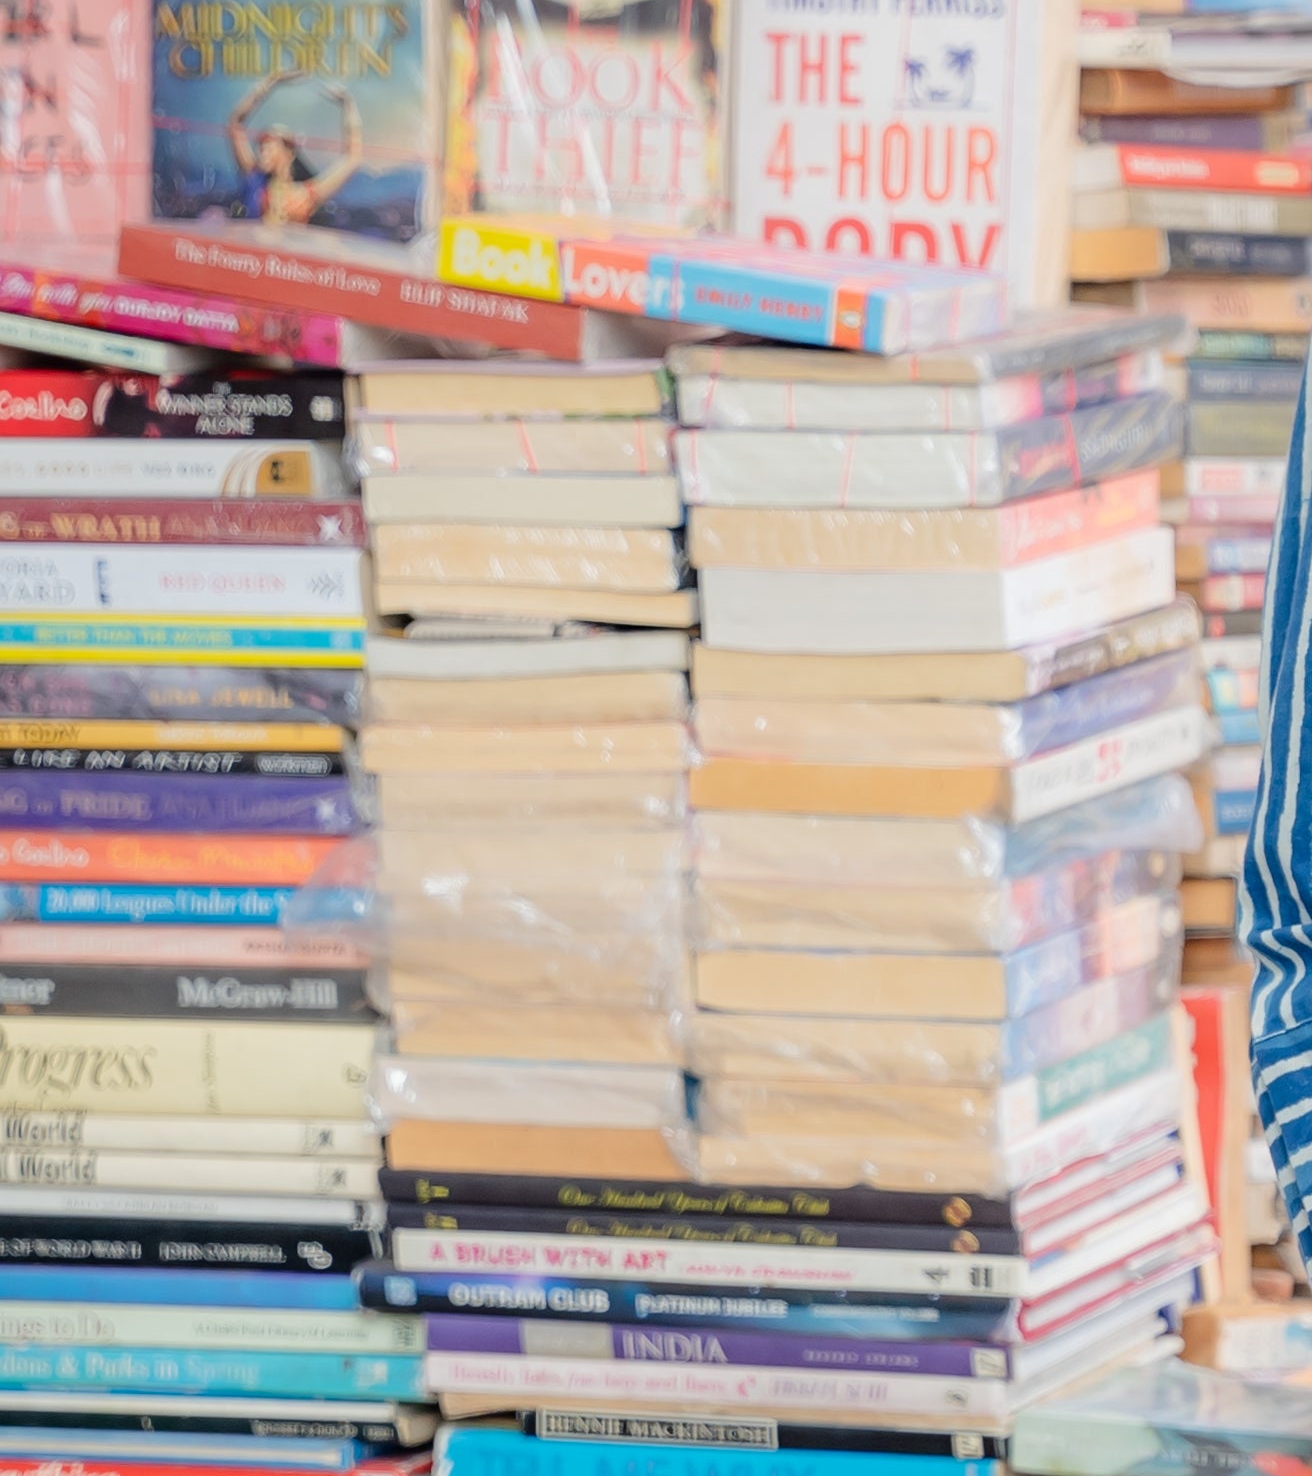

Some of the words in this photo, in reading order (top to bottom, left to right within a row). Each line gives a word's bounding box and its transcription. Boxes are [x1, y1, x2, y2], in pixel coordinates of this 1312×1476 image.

[168, 37, 393, 79] CHILDREN
[764, 32, 864, 107] THE
[764, 123, 999, 204] 4-HOUR
[174, 239, 209, 262] The
[211, 243, 265, 276] Forty
[267, 257, 321, 283] Rules
[450, 230, 553, 292] Book
[562, 252, 685, 313] Lovers
[157, 393, 228, 419] WINNER
[229, 393, 294, 418] STANDS
[196, 417, 256, 436] ALONE
[51, 511, 162, 543] WRATH
[158, 572, 206, 594] RED
[208, 574, 288, 596] QUEEN
[210, 687, 294, 710] JEWELL
[84, 750, 126, 771] AN
[131, 751, 243, 774] ARTIST
[59, 790, 153, 821] PRIDE
[177, 974, 339, 1010] McGraw-Hill
[4, 1115, 85, 1147] World
[17, 1151, 99, 1185] World
[159, 1240, 200, 1262] JOHN
[201, 1242, 287, 1264] CAMPBELL
[430, 1241, 447, 1263] A
[456, 1241, 535, 1268] BRUSH
[543, 1246, 613, 1272] WITH
[449, 1282, 546, 1313] OUTRAM
[549, 1287, 609, 1314] CLUB
[635, 1293, 728, 1321] PLATINUM
[621, 1329, 728, 1365] INDIA
